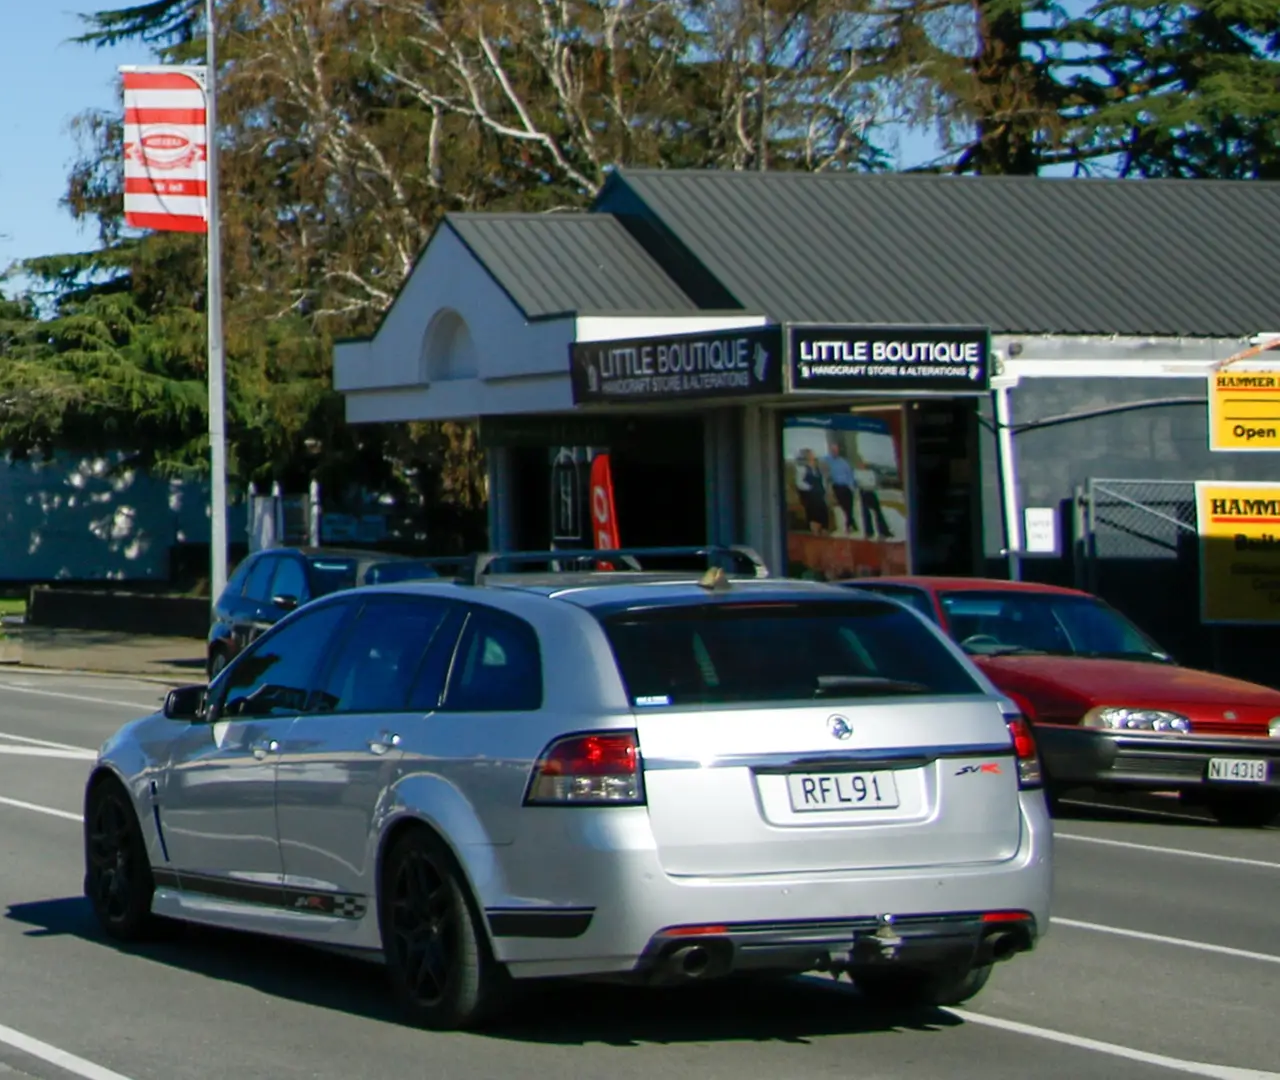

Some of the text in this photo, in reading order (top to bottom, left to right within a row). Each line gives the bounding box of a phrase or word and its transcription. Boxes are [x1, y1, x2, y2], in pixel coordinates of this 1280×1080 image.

[599, 339, 749, 377] LITTLE BOUTIQUE
[800, 341, 979, 363] LITTLE BOUTIQUE
[812, 365, 866, 376] HANDCRAFT
[868, 365, 897, 376] STORE
[906, 365, 967, 376] ALTERATIONS
[1216, 376, 1275, 387] HAMMER
[1232, 424, 1277, 441] Open
[1210, 498, 1280, 516] HAMM
[801, 775, 883, 804] RFL91
